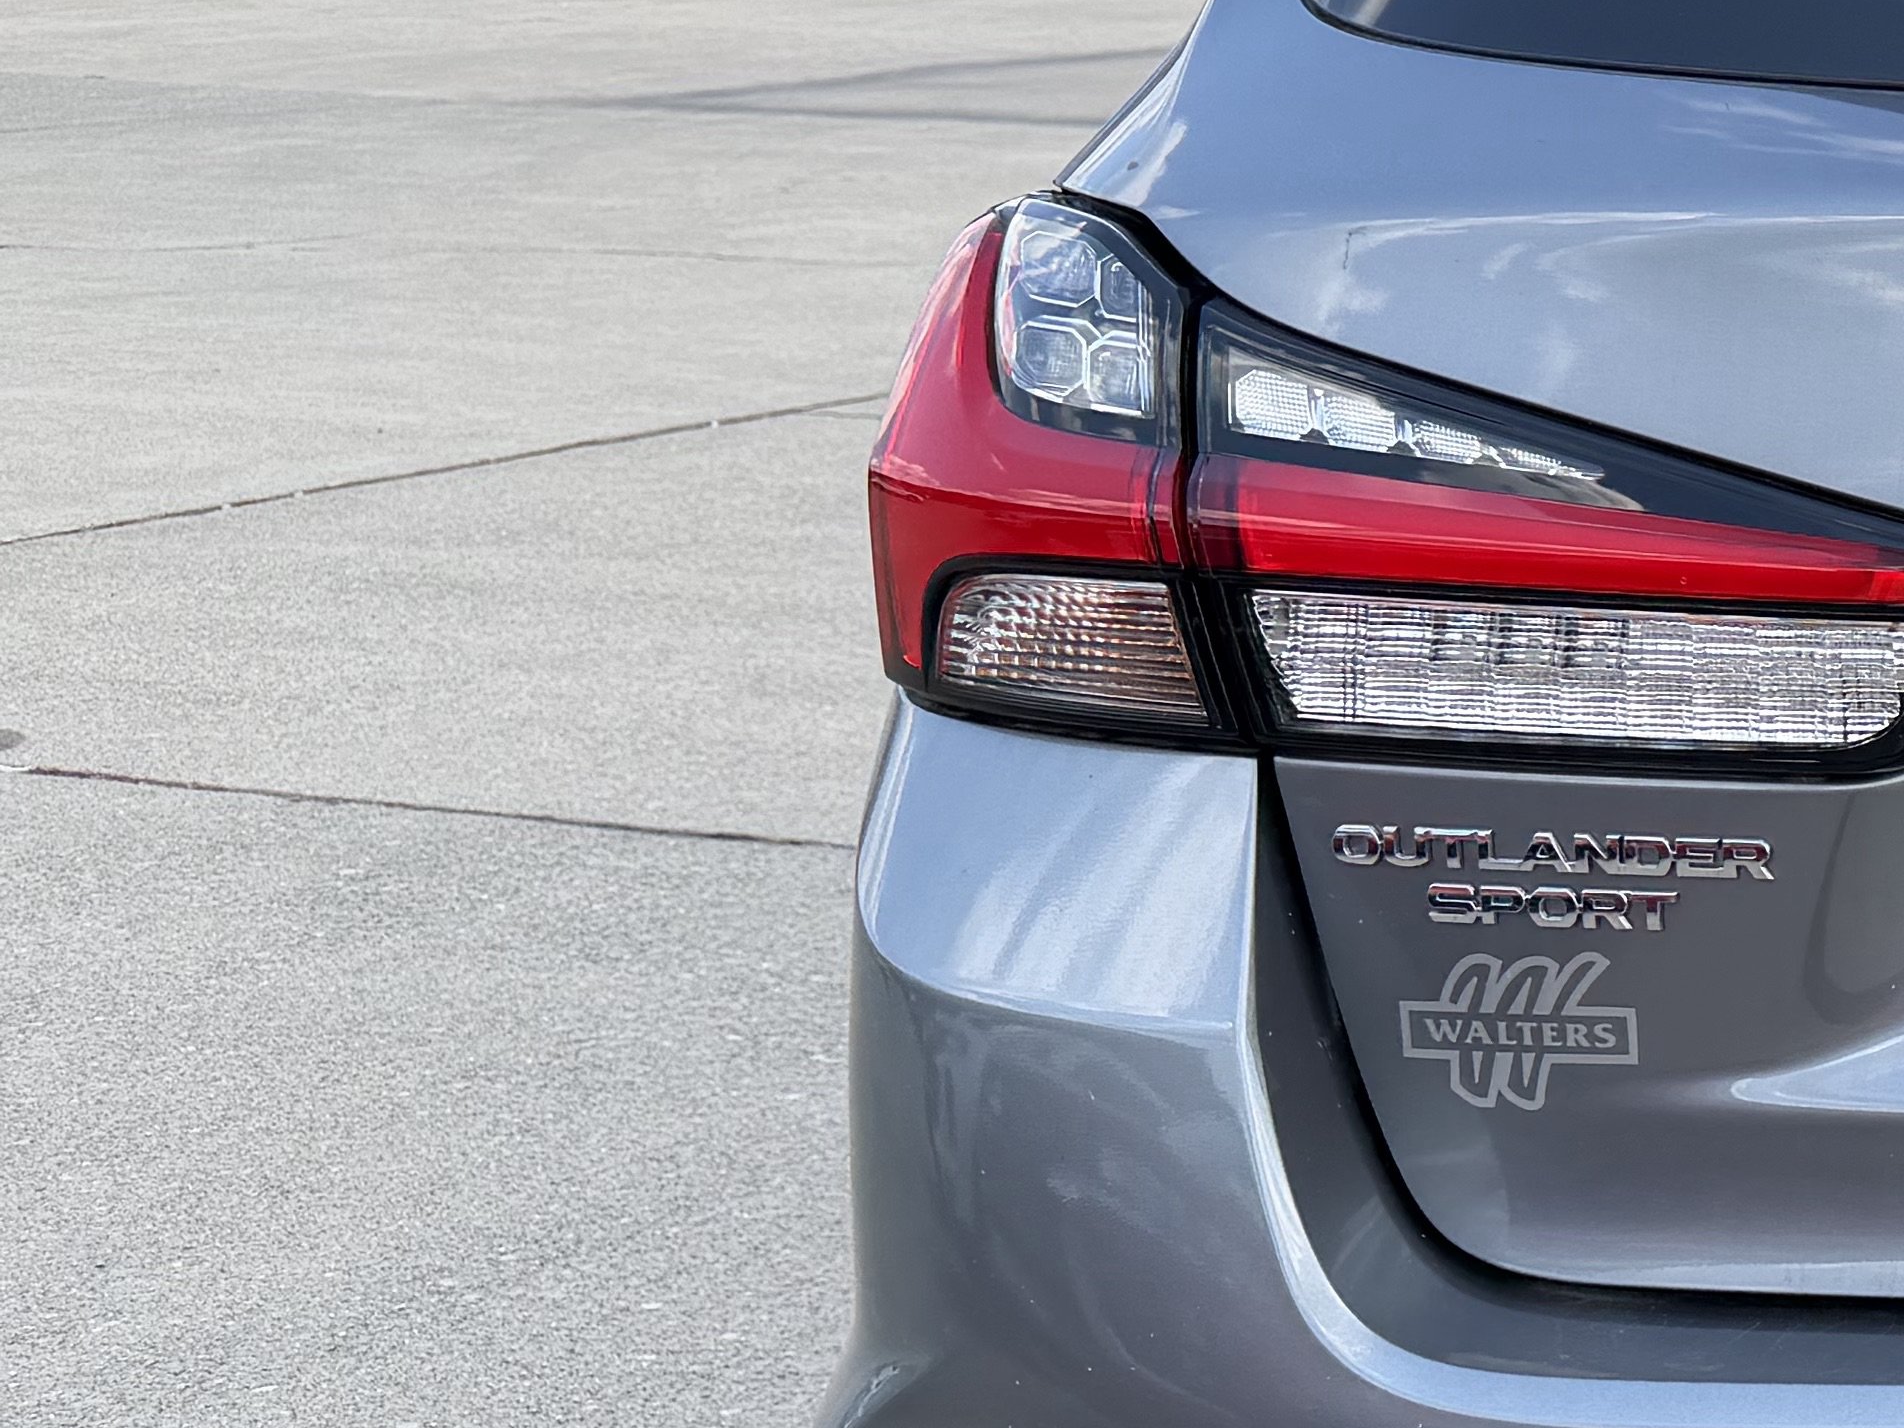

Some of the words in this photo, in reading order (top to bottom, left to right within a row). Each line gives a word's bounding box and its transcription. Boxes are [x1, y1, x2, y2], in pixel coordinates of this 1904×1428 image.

[1331, 823, 1776, 881] OUTLANDER
[1426, 881, 1682, 932] SPORT
[1422, 1017, 1618, 1049] WALTERS
